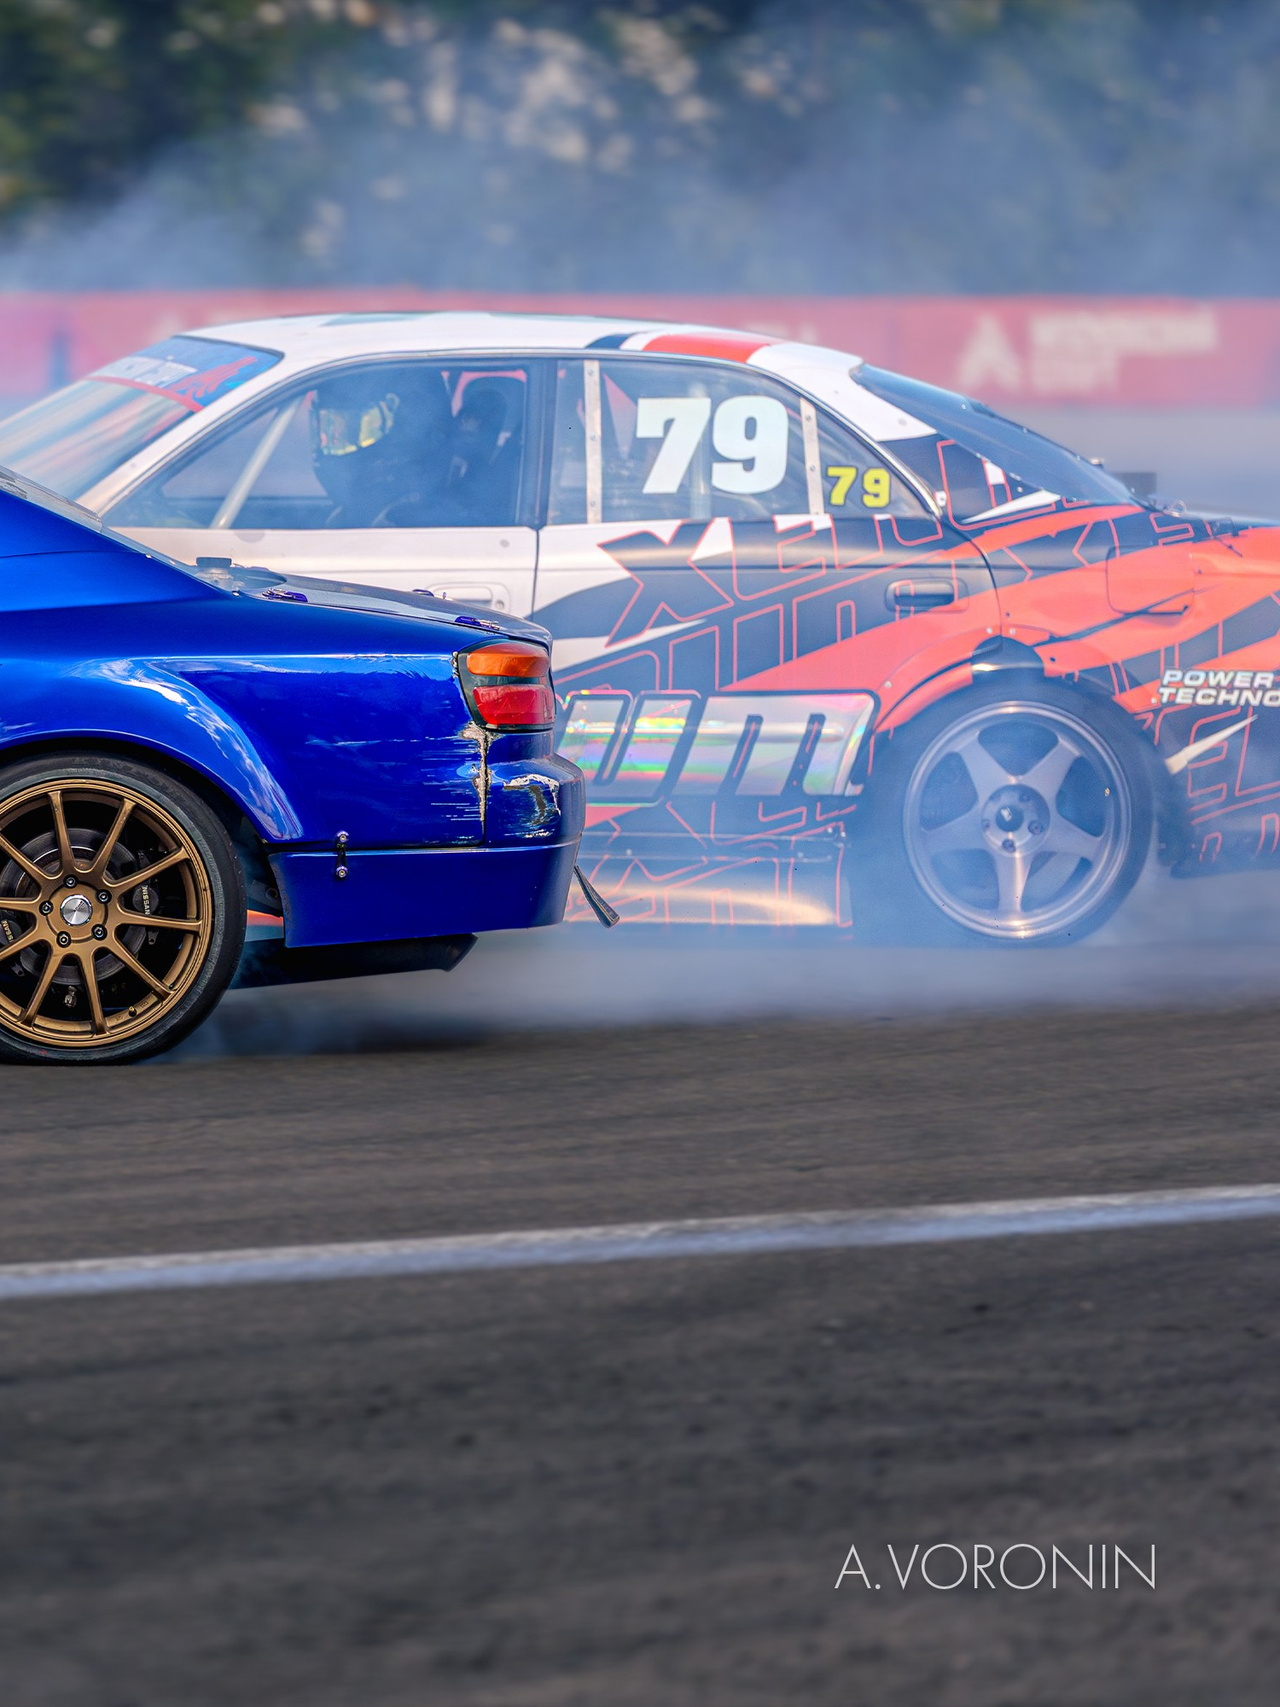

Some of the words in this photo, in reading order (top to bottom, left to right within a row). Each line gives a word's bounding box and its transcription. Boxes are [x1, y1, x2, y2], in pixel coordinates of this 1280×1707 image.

[636, 394, 789, 494] 79
[826, 465, 891, 508] 79
[1162, 669, 1274, 689] POWER
[1158, 686, 1280, 707] TECHNO
[141, 884, 150, 915] NISSAN
